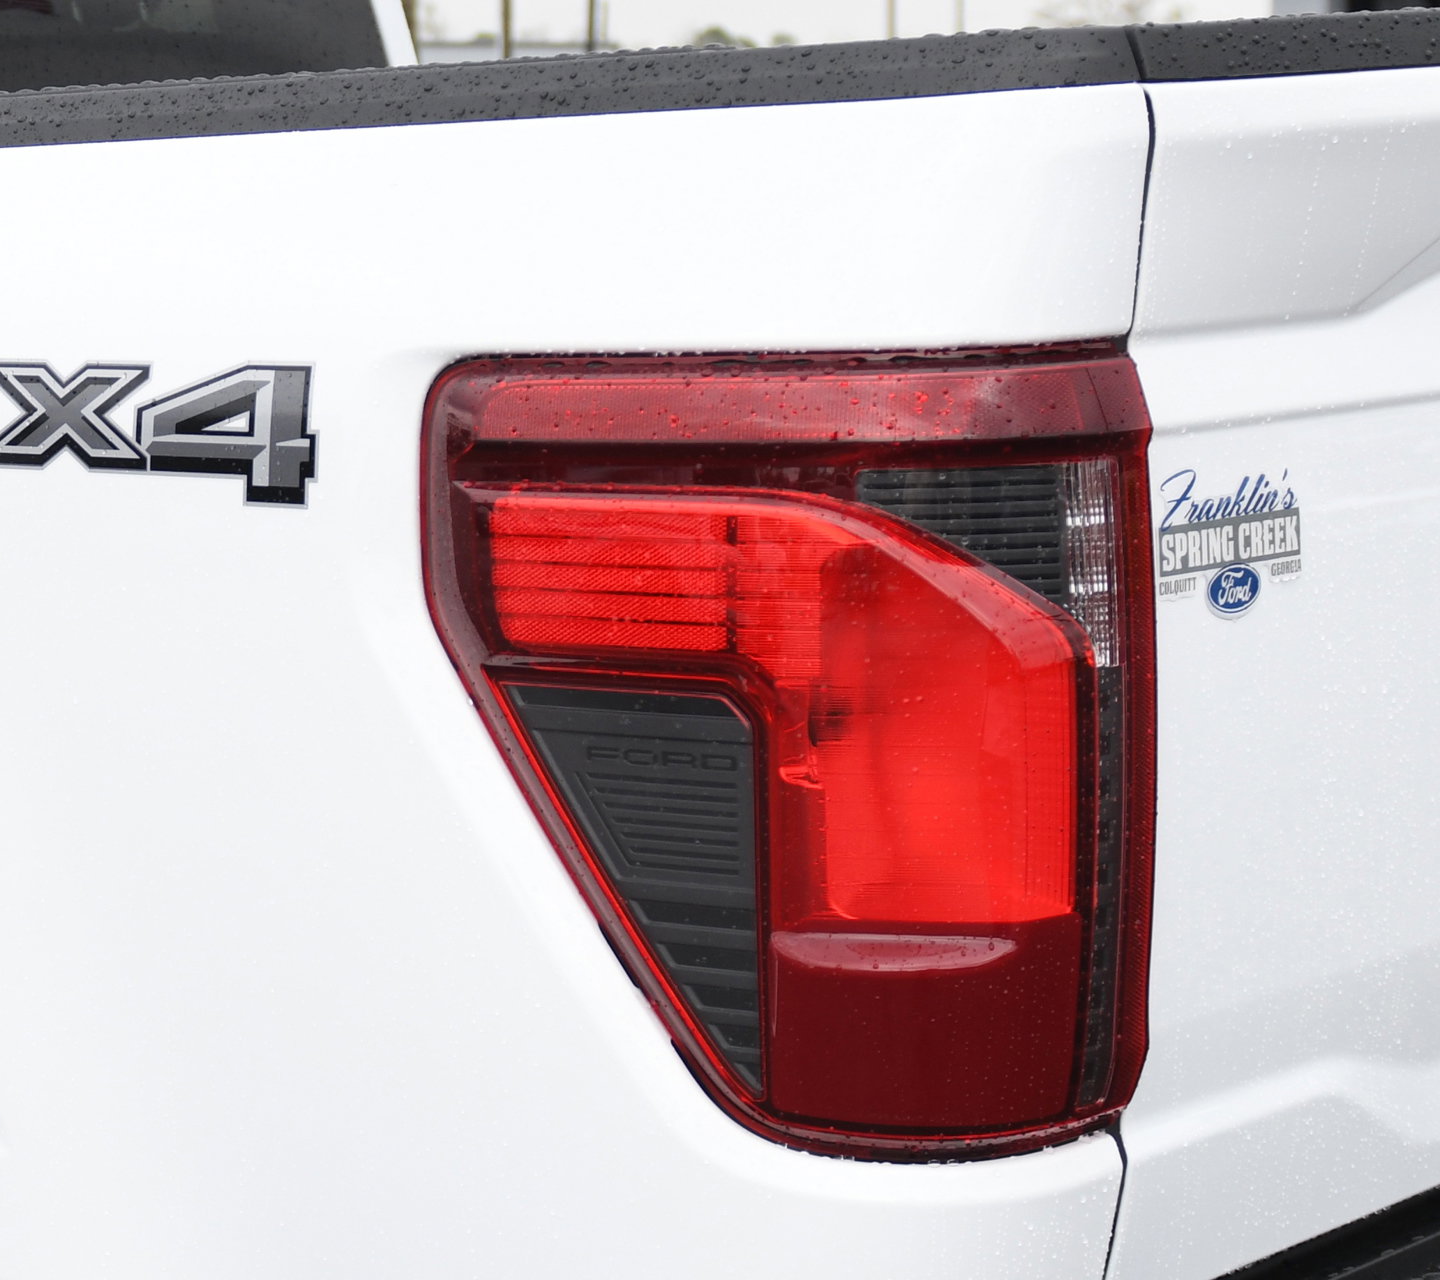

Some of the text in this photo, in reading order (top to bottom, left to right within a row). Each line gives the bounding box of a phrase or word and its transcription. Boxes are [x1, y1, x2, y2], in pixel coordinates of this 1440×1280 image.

[1160, 468, 1298, 532] Franklin's
[1161, 515, 1299, 572] SPRING CREEK
[1270, 558, 1302, 577] GEORGIA
[1159, 577, 1197, 596] COLQUITT
[1218, 569, 1252, 606] Ford
[586, 745, 738, 772] FORD
